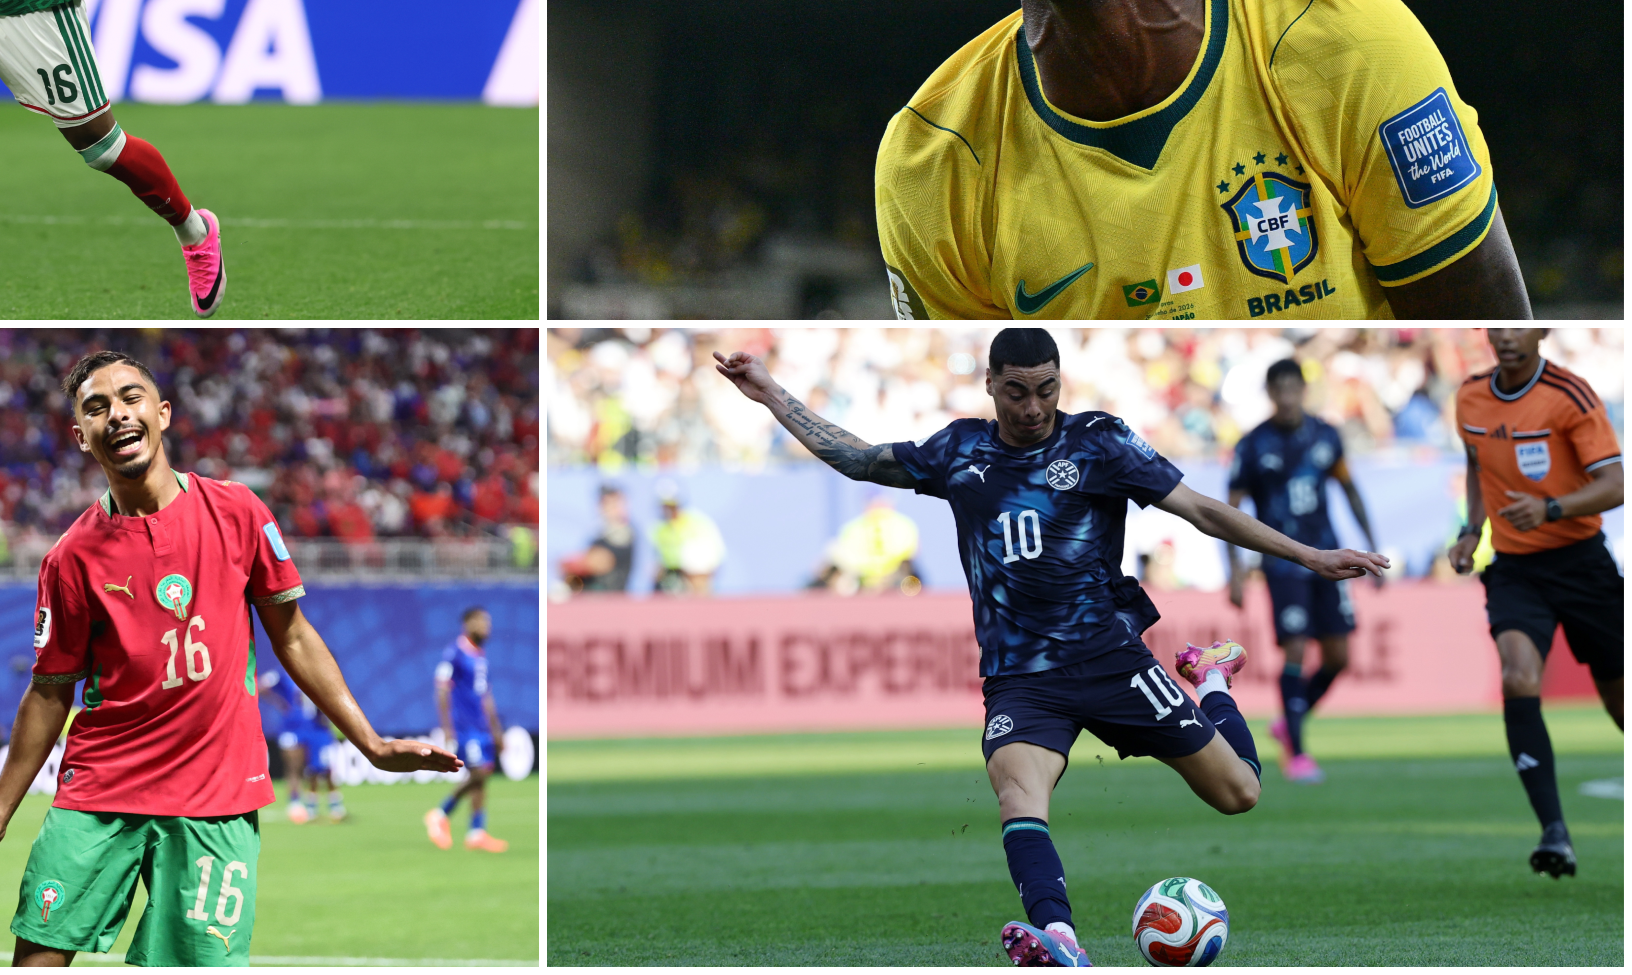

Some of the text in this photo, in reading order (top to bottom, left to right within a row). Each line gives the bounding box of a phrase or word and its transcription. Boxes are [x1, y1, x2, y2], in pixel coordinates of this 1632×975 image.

[37, 64, 78, 105] 16
[1398, 109, 1446, 145] FOOTBALL
[1404, 122, 1452, 162] UNITES
[1408, 139, 1461, 180] the World
[1431, 168, 1454, 184] FIFA
[1258, 214, 1289, 234] CBF
[1178, 303, 1194, 311] 2026
[1247, 279, 1336, 318] BRASIL
[997, 510, 1043, 564] 10
[160, 615, 212, 690] 16
[1130, 664, 1184, 722] 10
[186, 856, 248, 926] 16
